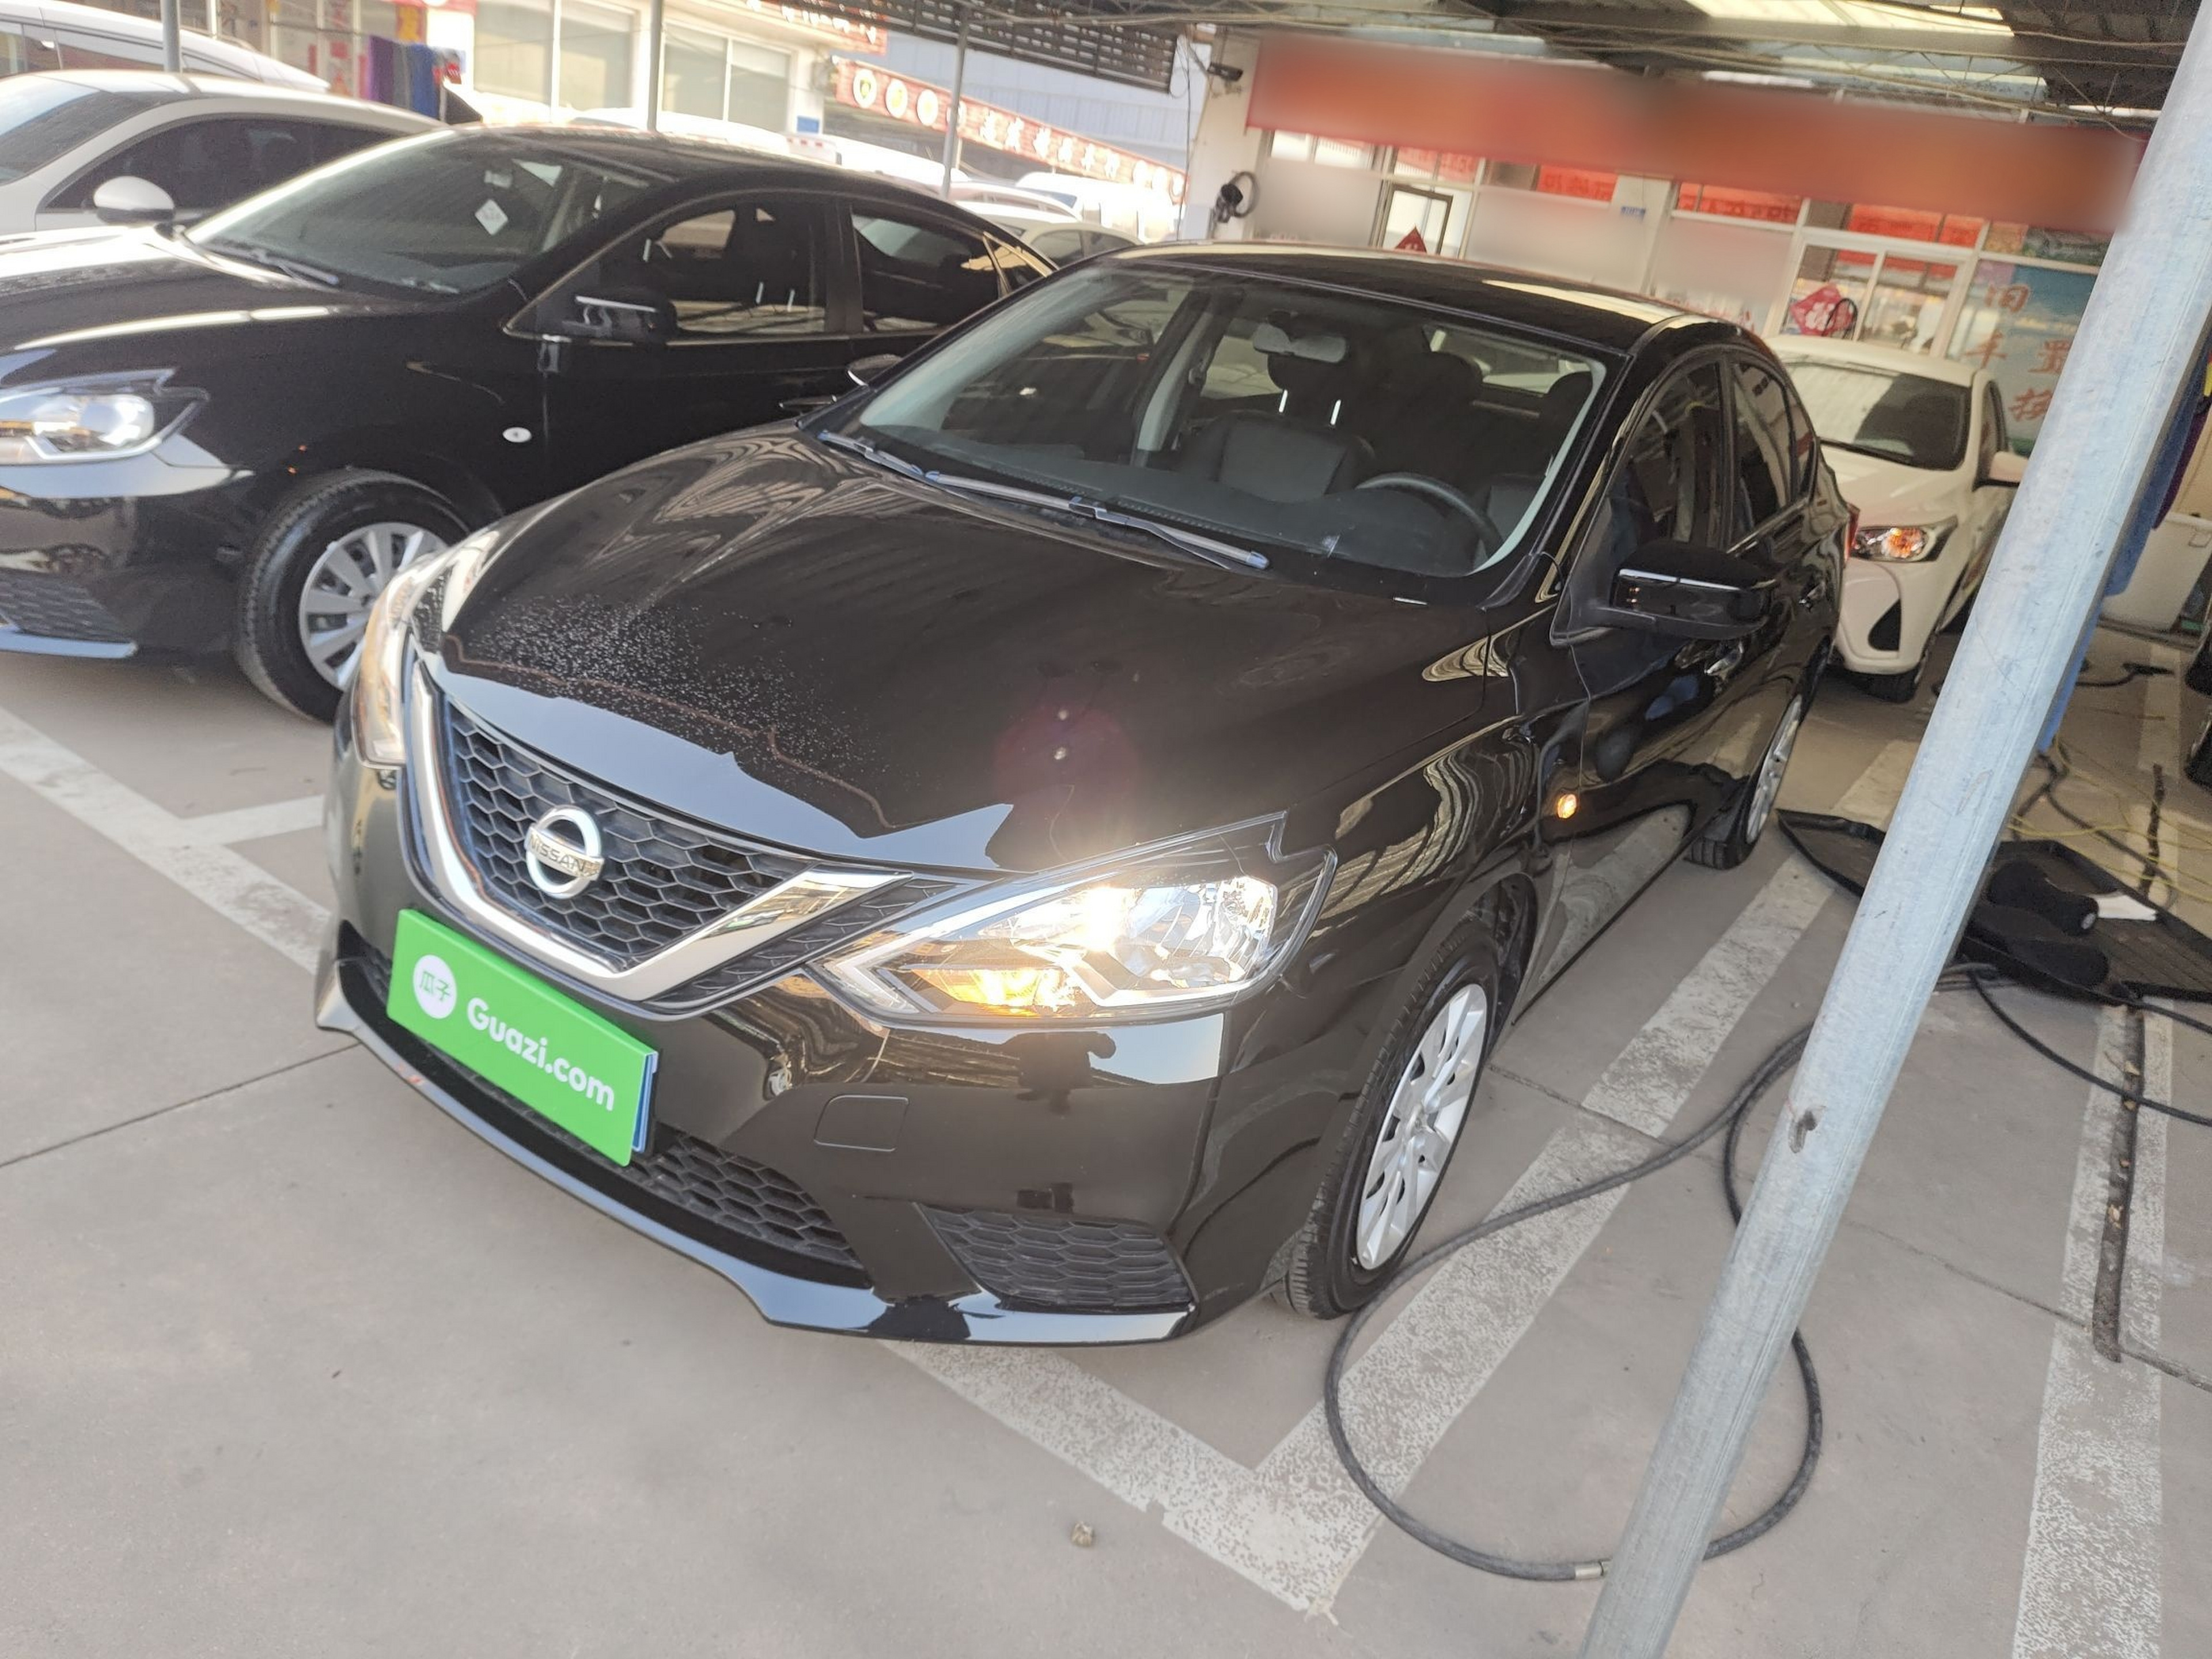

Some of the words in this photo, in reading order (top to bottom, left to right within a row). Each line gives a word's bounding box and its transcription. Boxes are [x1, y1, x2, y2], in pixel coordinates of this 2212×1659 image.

[529, 833, 586, 872] NISSAN
[419, 970, 451, 1002] 瓜子
[467, 998, 615, 1111] Guazi.com
